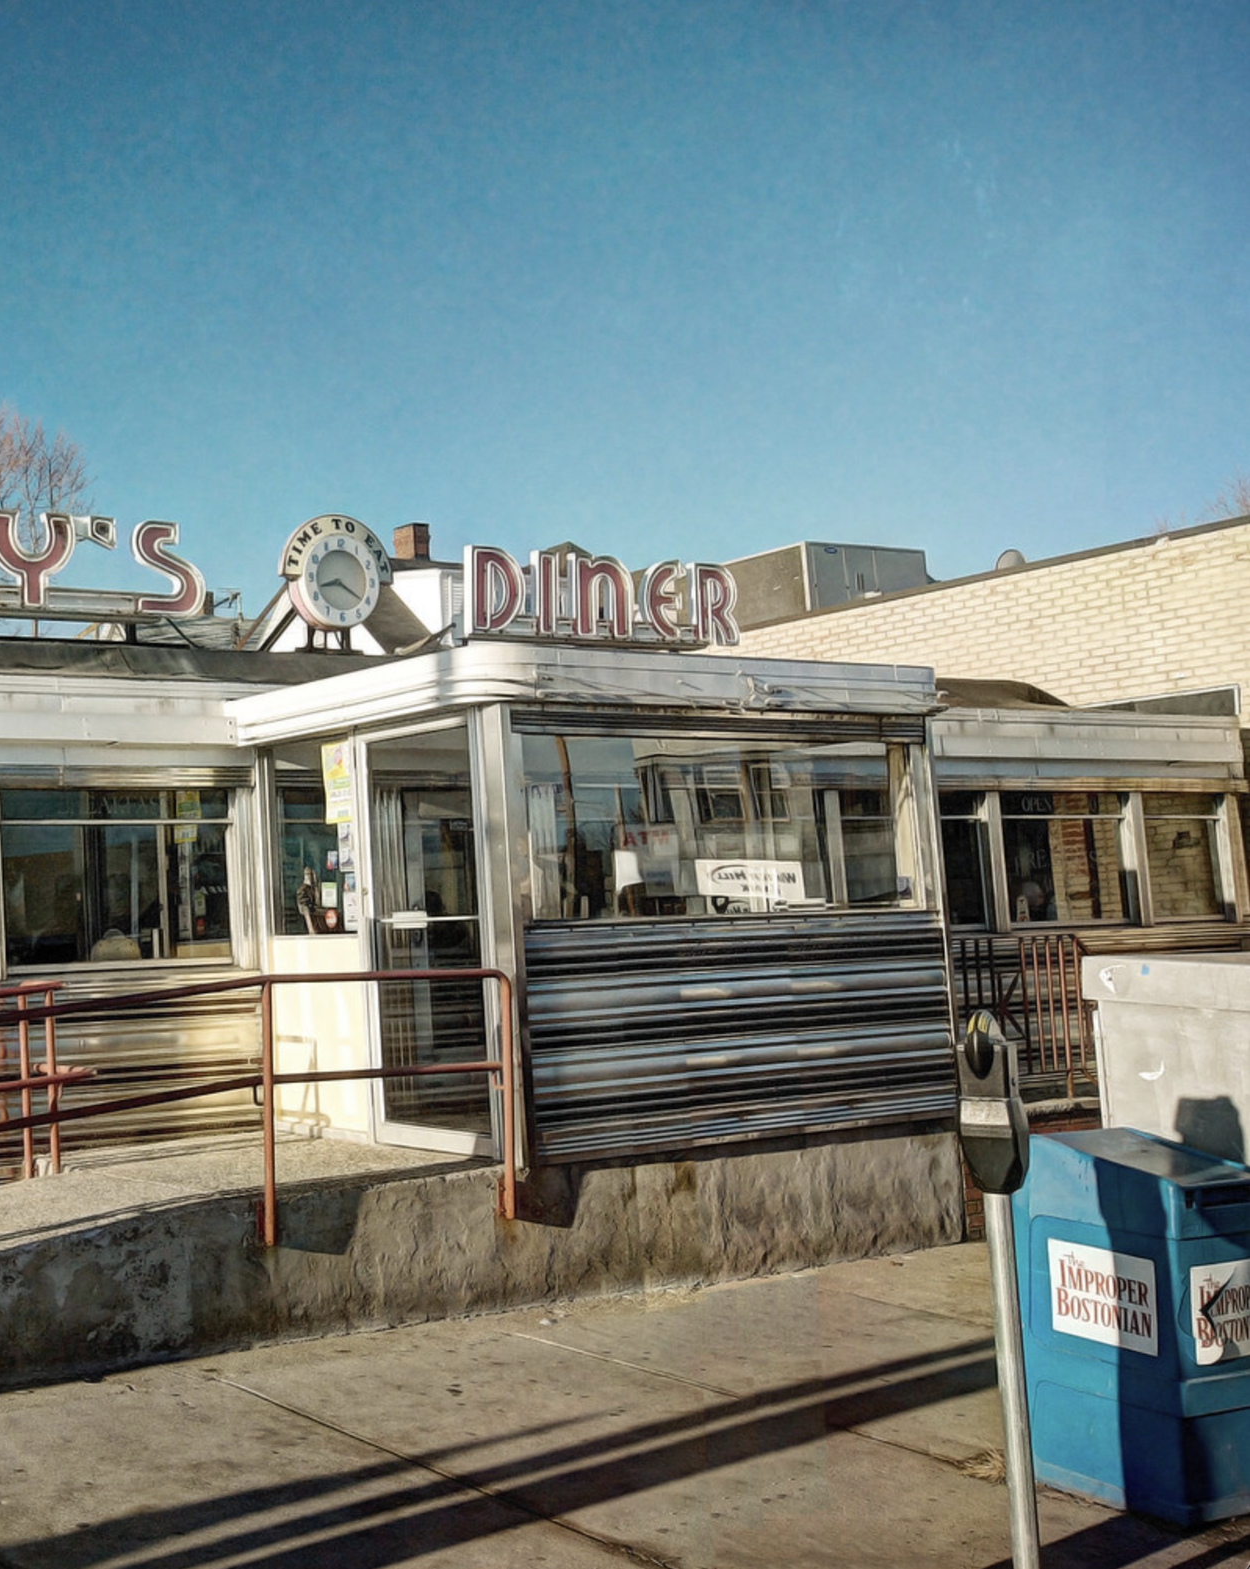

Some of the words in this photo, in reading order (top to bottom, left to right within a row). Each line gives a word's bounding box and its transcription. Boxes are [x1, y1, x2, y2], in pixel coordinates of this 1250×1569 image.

[287, 522, 323, 567] TIME
[331, 518, 356, 534] TO
[364, 533, 390, 574] EAT
[464, 545, 740, 646] DINER
[1059, 1259, 1148, 1308] IMPROPER
[1056, 1287, 1152, 1338] BOSTONIAN
